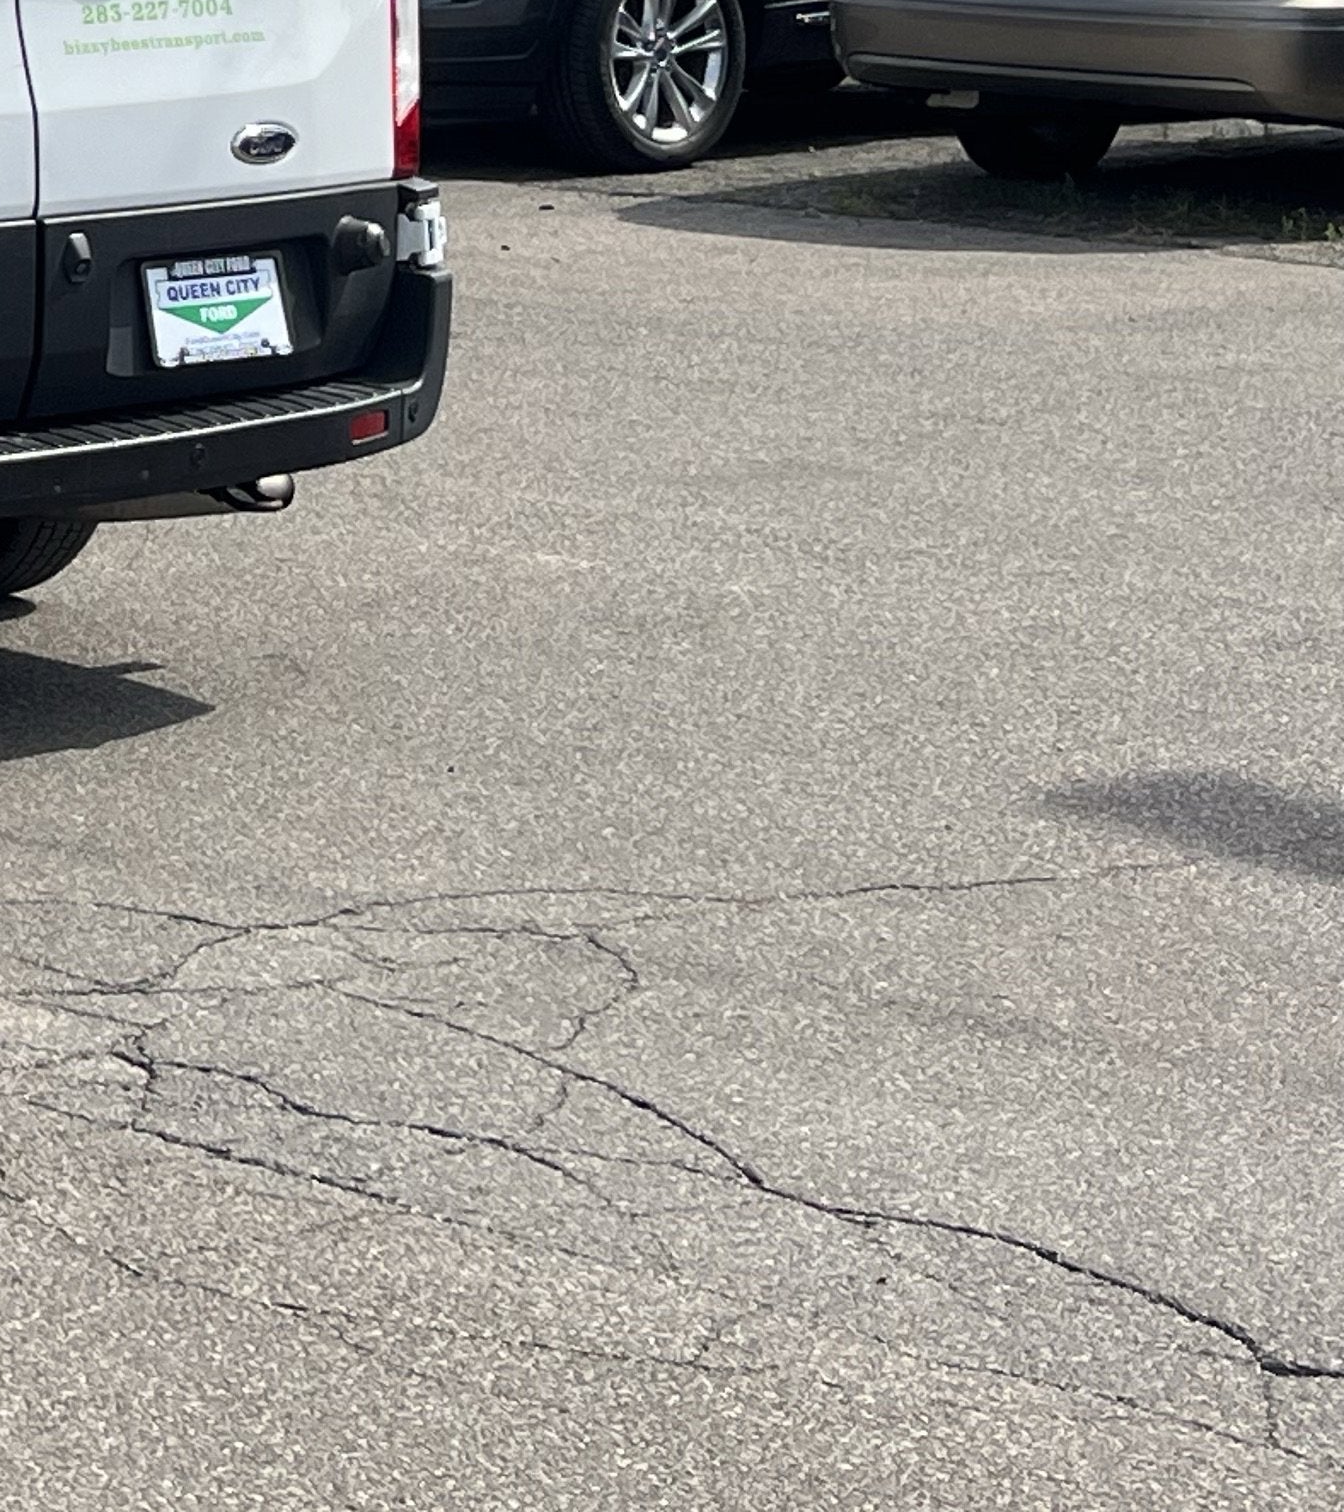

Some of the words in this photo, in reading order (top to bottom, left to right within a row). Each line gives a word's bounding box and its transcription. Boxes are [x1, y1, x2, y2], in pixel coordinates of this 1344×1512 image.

[166, 281, 221, 302] QUEEN
[225, 277, 260, 296] CITY
[199, 304, 238, 323] FORD
